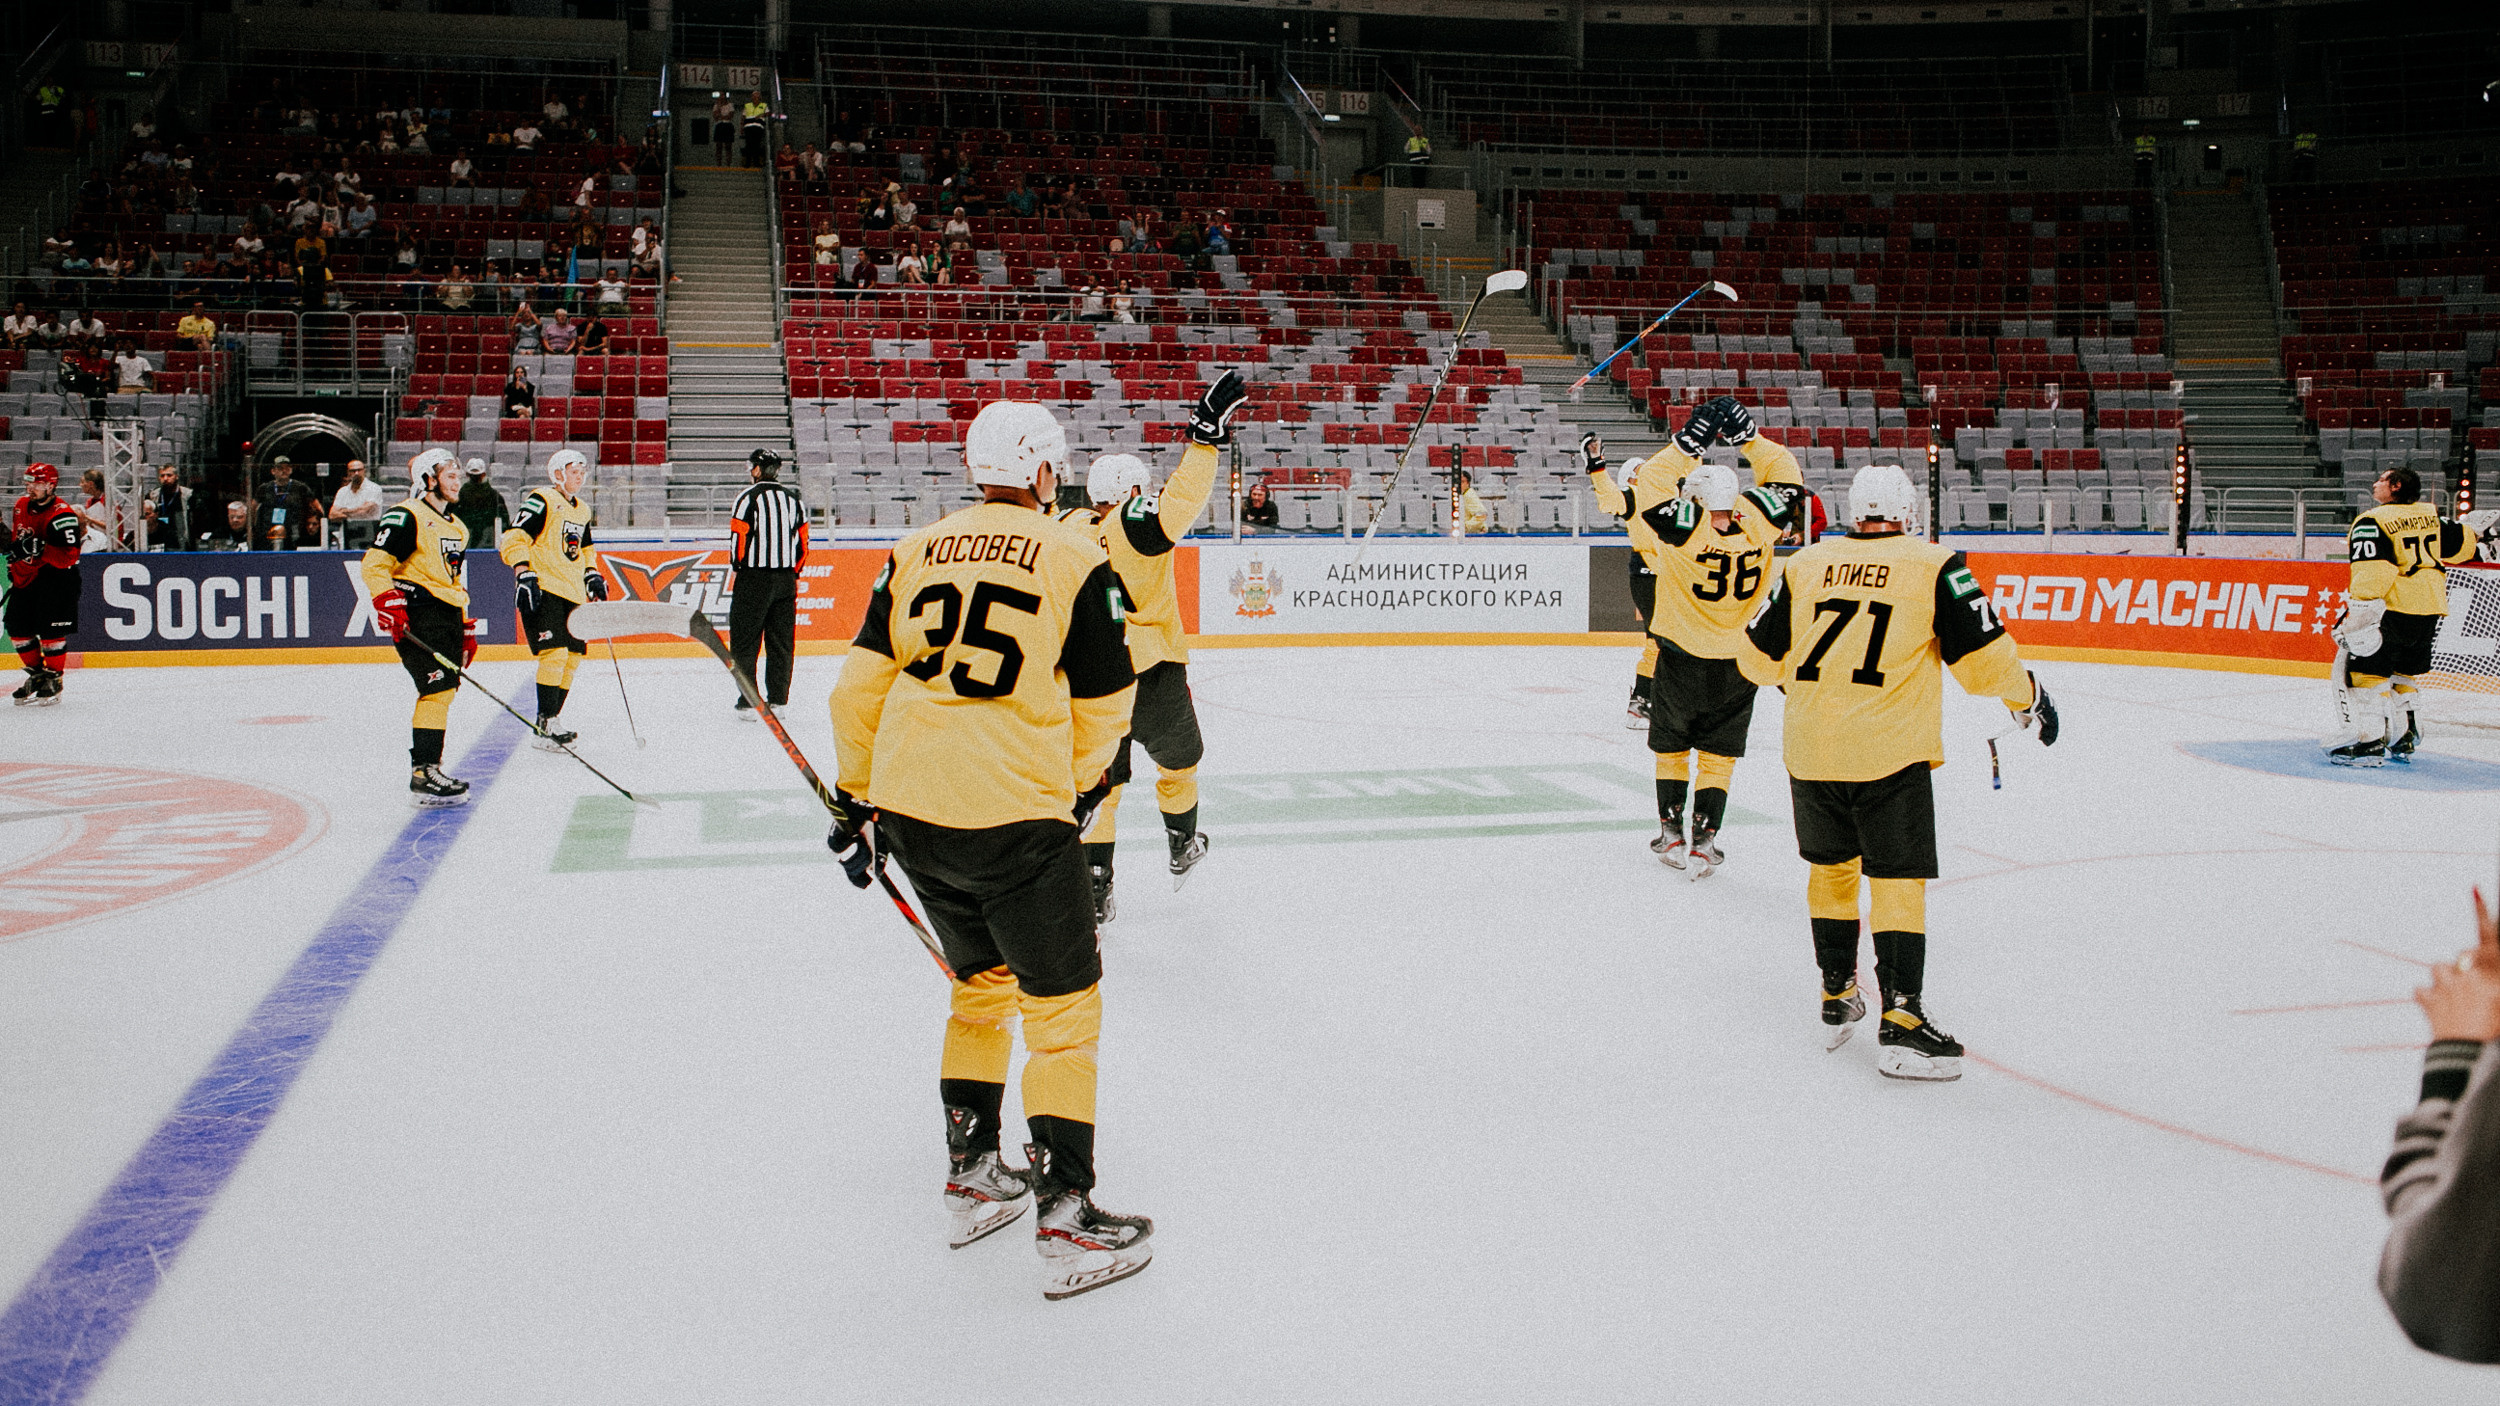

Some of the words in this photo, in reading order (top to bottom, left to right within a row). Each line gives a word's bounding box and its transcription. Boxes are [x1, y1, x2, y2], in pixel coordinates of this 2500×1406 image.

[88, 43, 121, 63] 113
[681, 66, 711, 85] 114
[730, 68, 760, 87] 115
[1341, 94, 1368, 111] 116
[64, 528, 76, 545] 5
[922, 534, 1042, 574] КОСОВЕЦ
[2352, 540, 2377, 560] 70
[1326, 563, 1529, 584] АДМИНИСТРАЦИЯ
[1691, 548, 1763, 602] 36
[1822, 563, 1890, 589] АЛИЕВ
[102, 562, 310, 641] SOCHI
[1293, 590, 1497, 610] КРАСНОДАРСКОГО
[1504, 590, 1563, 608] КРАЯ
[1992, 574, 2087, 622] RED
[2090, 577, 2310, 634] MACHINE
[903, 580, 1043, 699] 35
[1795, 597, 1894, 688] 71
